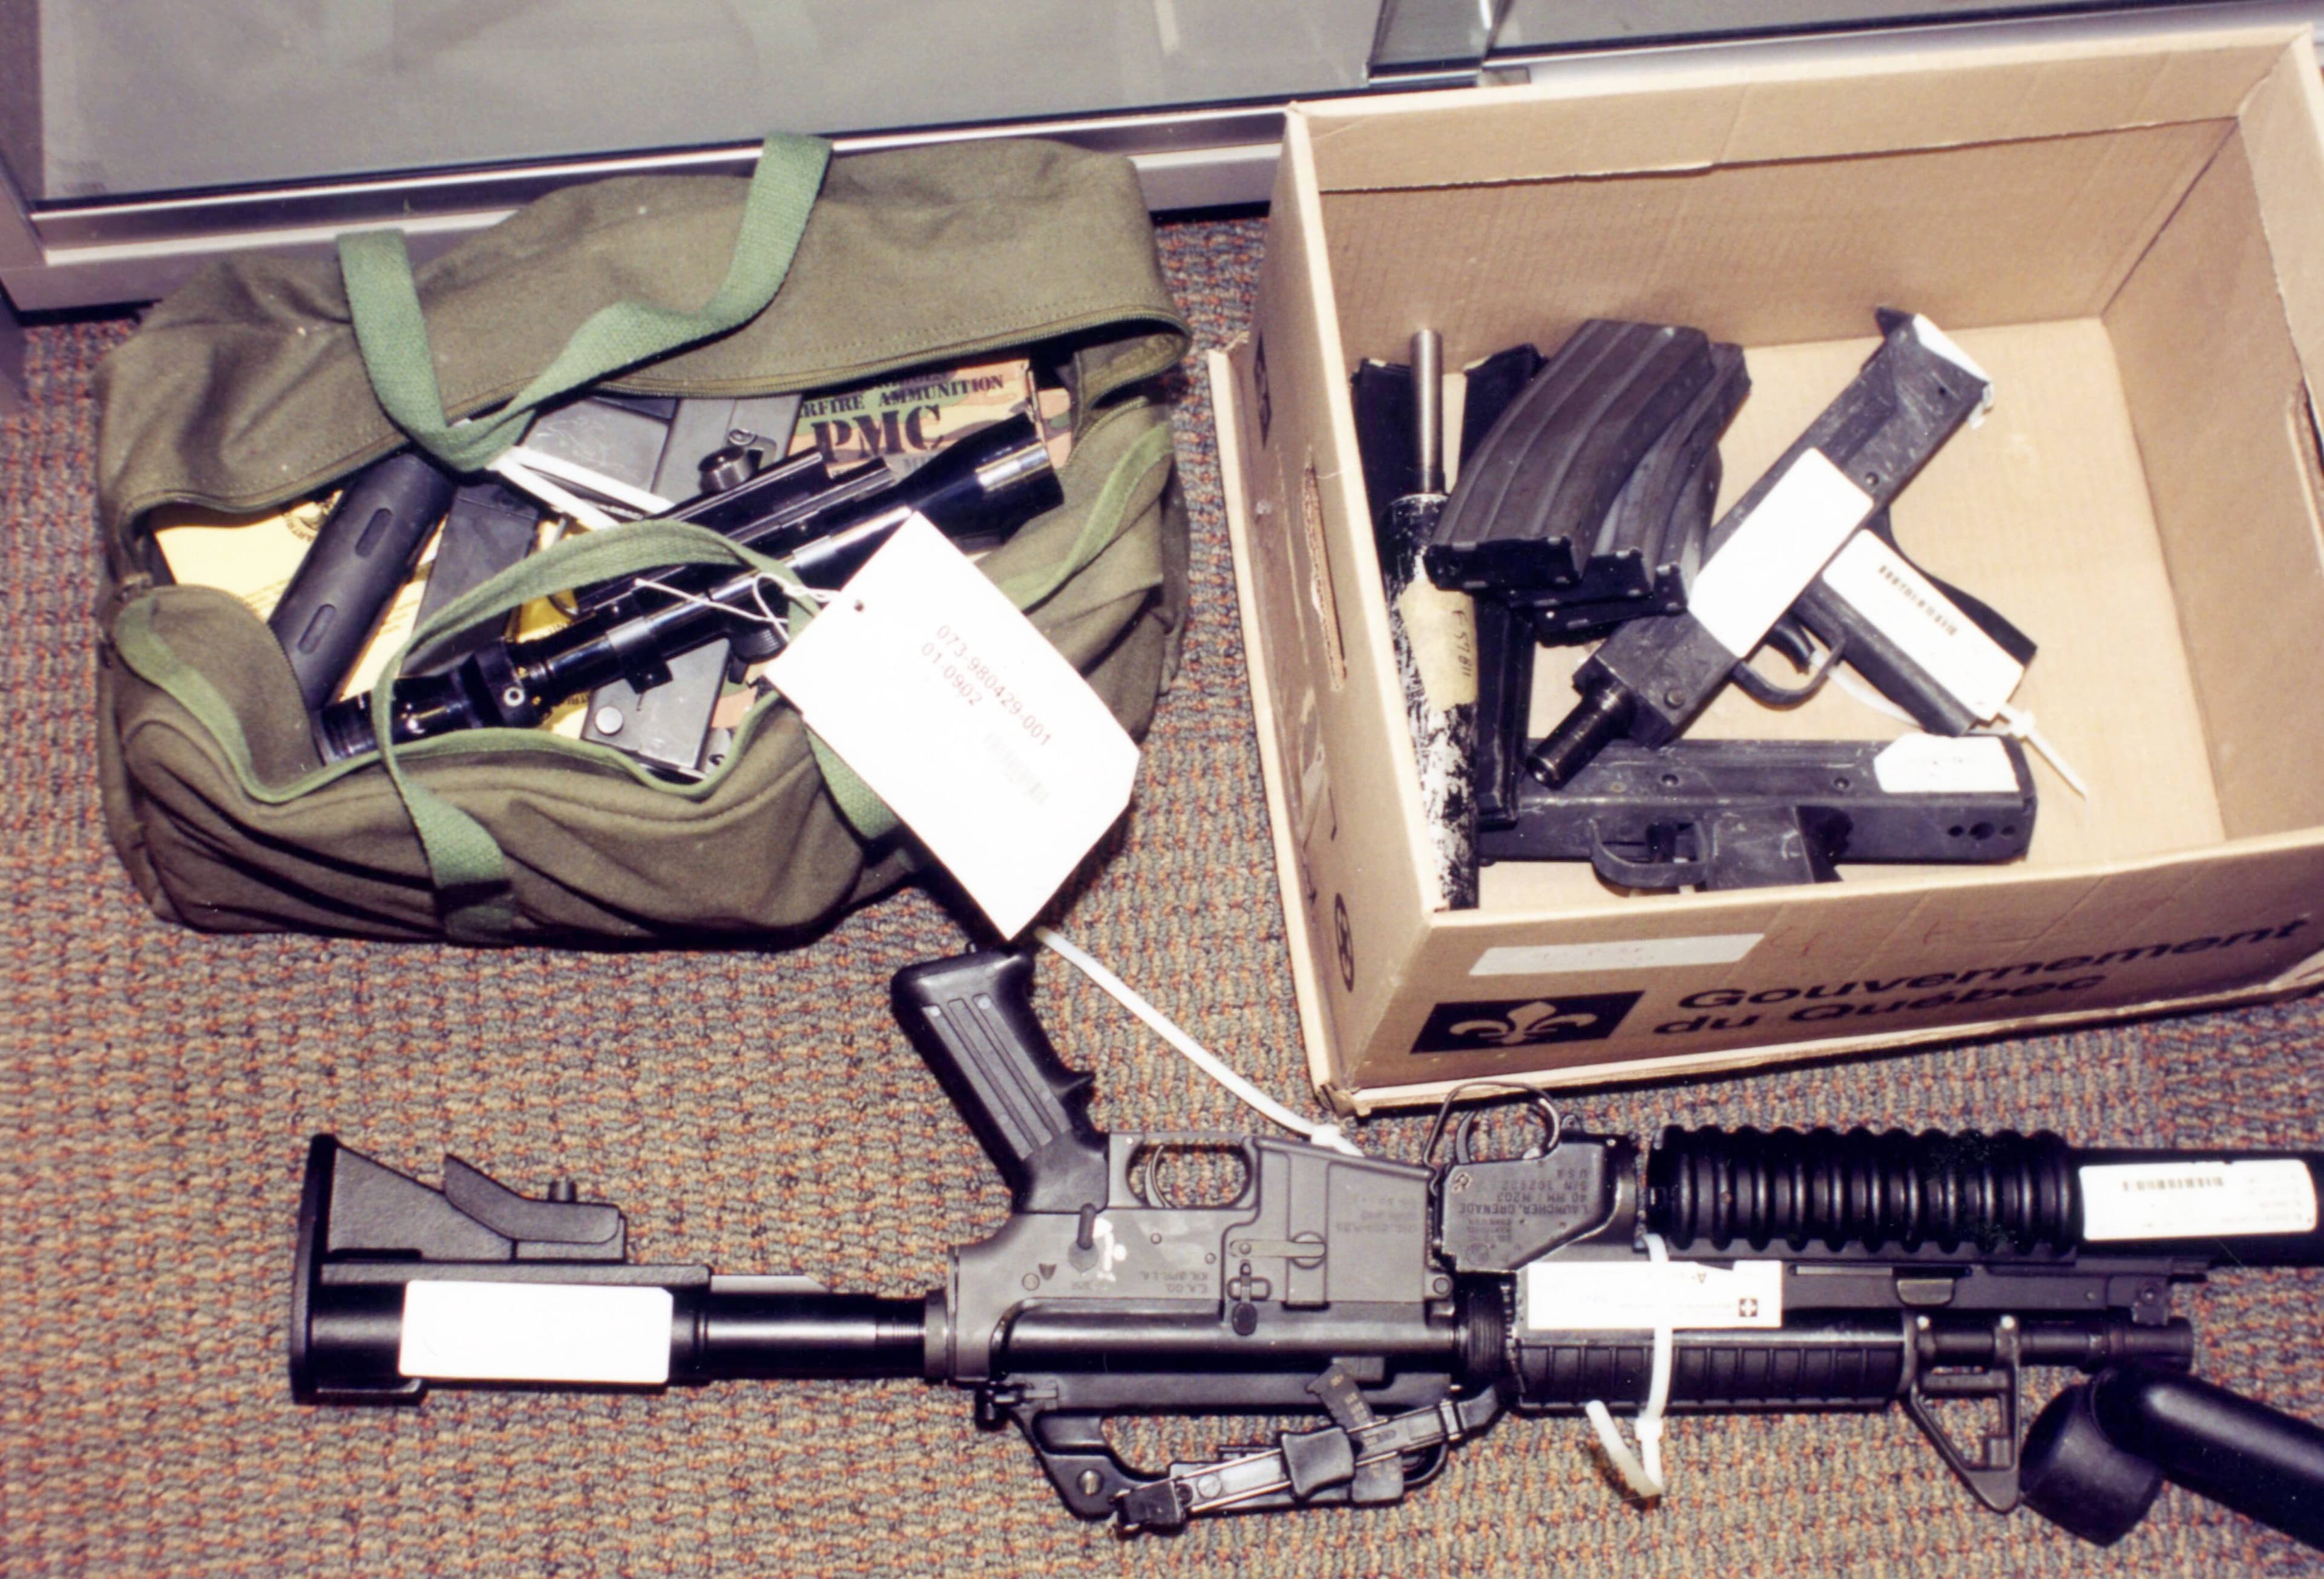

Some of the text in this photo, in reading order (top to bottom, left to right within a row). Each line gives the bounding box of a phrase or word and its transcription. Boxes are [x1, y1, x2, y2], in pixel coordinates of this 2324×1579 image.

[801, 395, 864, 418] RFIRE
[879, 375, 1004, 407] AMMUNITION
[811, 404, 944, 464] PMC
[936, 625, 1052, 746] 073-980429-001
[1678, 918, 2308, 1009] Gouvernement
[1653, 1010, 1761, 1036] du
[1459, 1203, 1515, 1215] GRENADE
